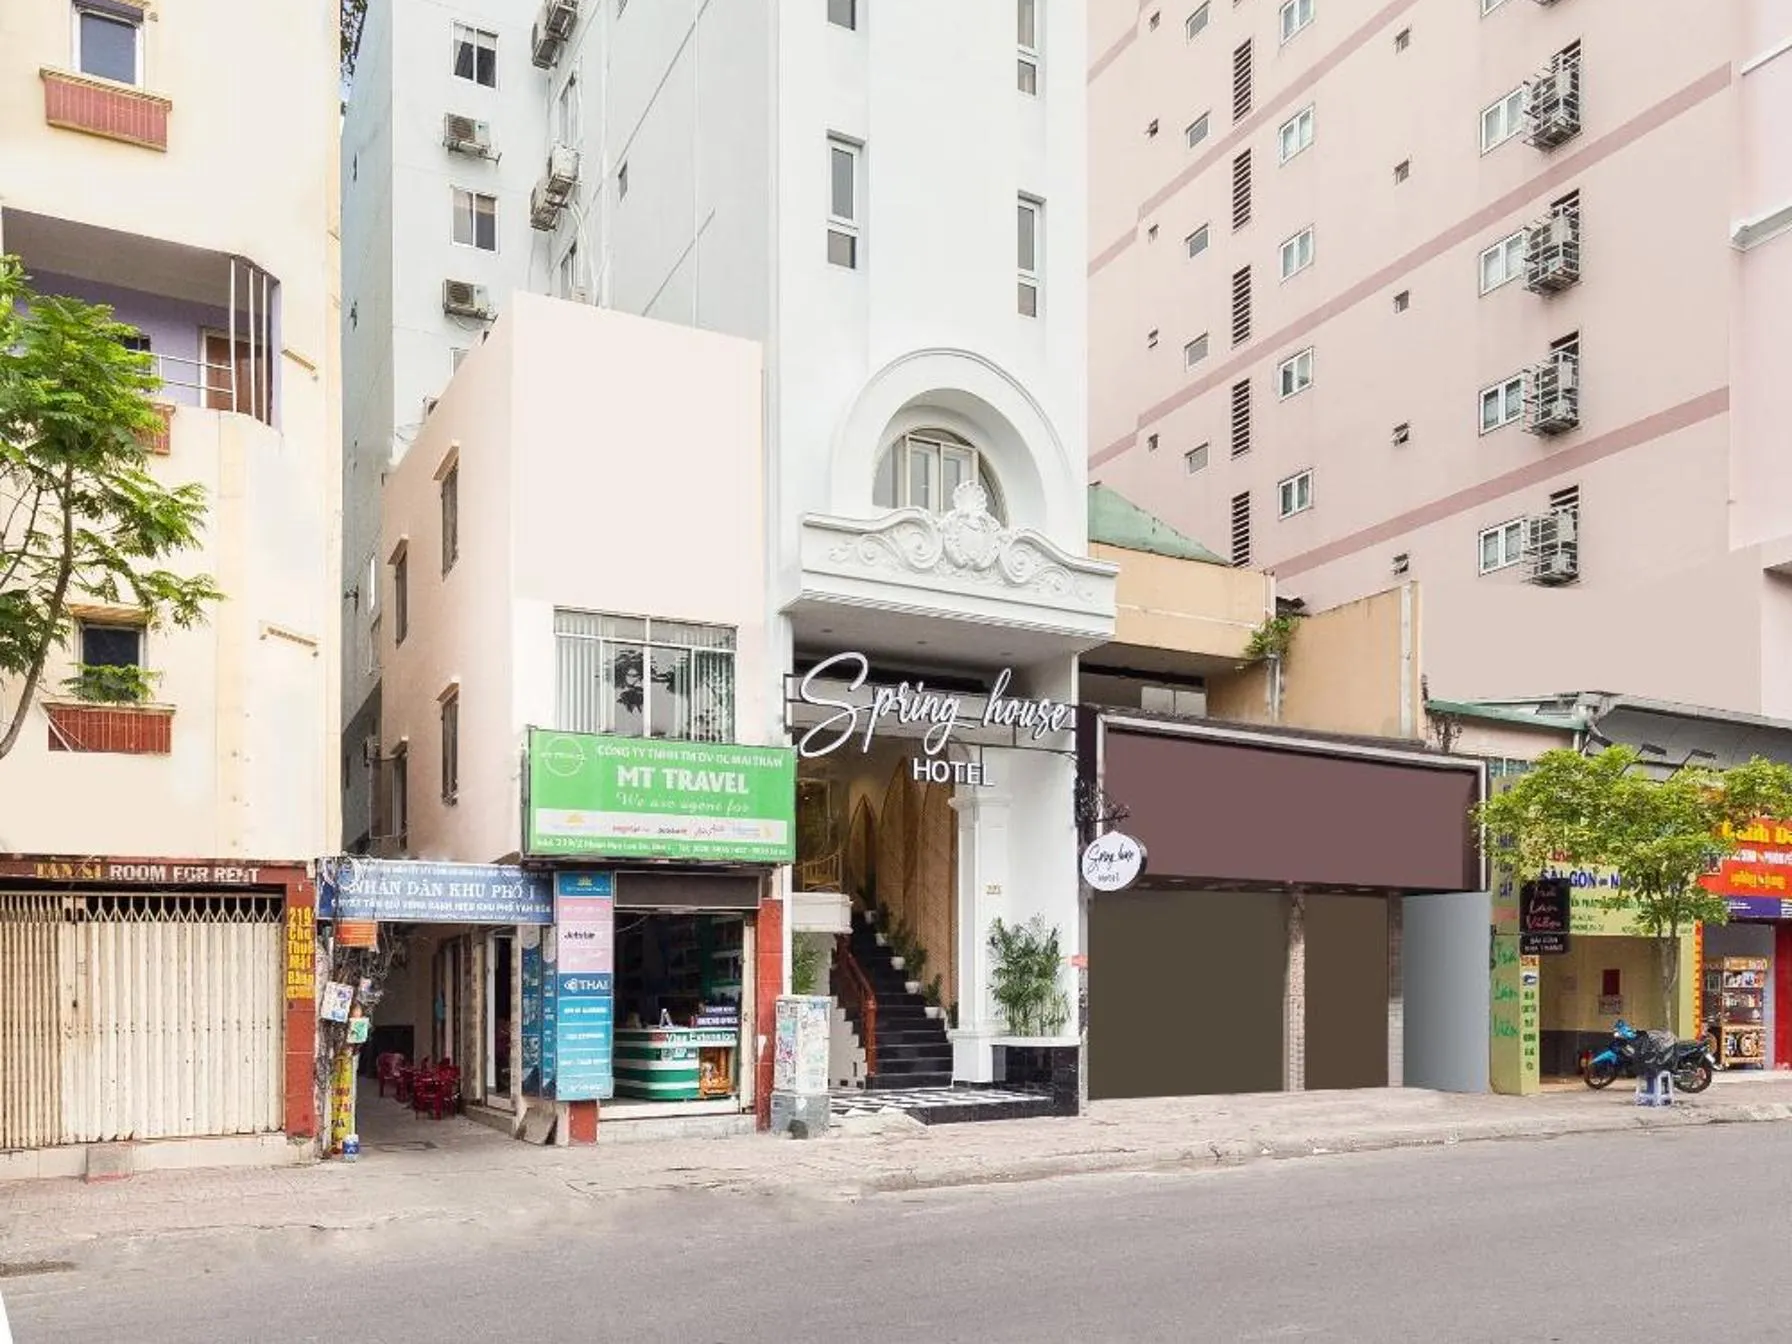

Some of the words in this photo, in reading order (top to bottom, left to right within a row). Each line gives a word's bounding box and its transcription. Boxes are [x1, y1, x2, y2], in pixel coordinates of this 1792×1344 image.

[800, 652, 974, 757] Spring
[984, 668, 1068, 740] house
[616, 765, 657, 788] MT
[661, 767, 749, 795] TRAVEL
[913, 757, 996, 787] HOTEL
[109, 864, 166, 881] ROOM
[173, 866, 209, 882] FOR
[214, 867, 260, 884] RENT
[449, 881, 486, 898] KHU
